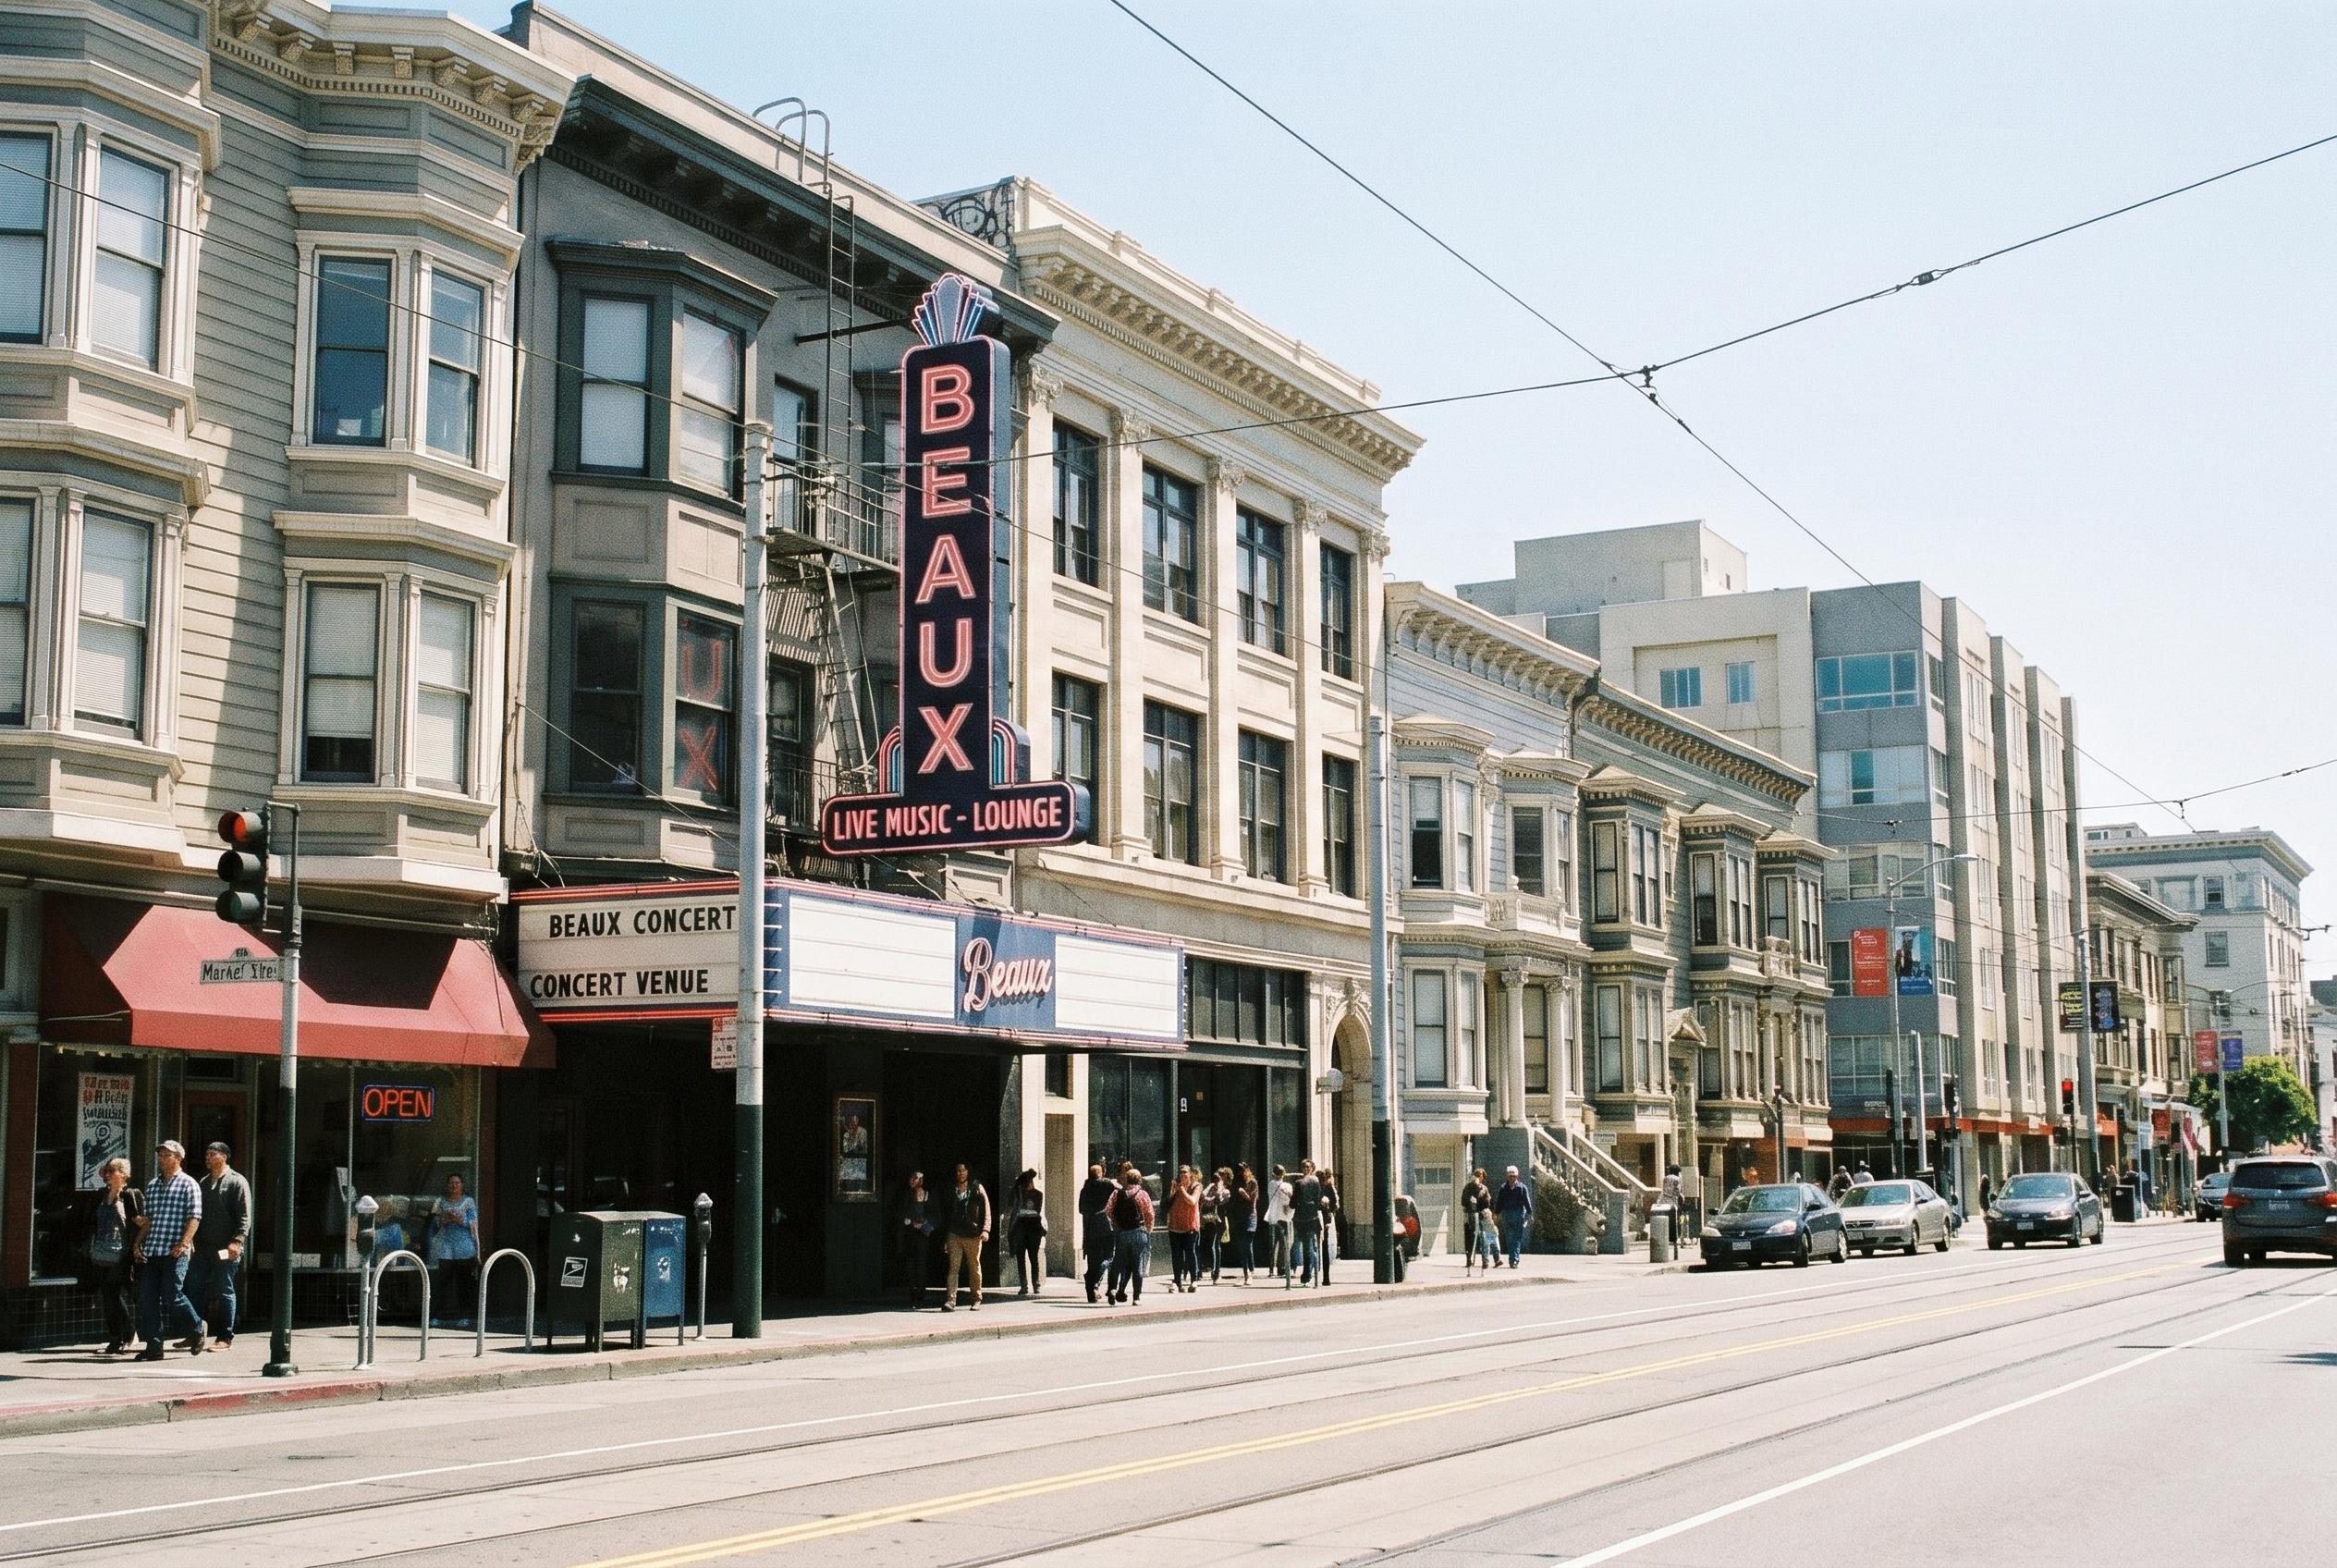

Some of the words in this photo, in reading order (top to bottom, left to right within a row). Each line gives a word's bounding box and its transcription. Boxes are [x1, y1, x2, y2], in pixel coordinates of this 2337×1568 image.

[915, 364, 976, 774] BEAUX
[834, 809, 878, 840] LIVE
[886, 804, 951, 837] MUSIC
[973, 796, 1062, 832] LOUNGE
[549, 911, 621, 937] BEAUX
[633, 906, 736, 934] CONCERT
[531, 973, 626, 998] CONCERT
[636, 970, 708, 995] VENUE
[963, 937, 1053, 1012] Beaux
[364, 1088, 432, 1117] OPEN
